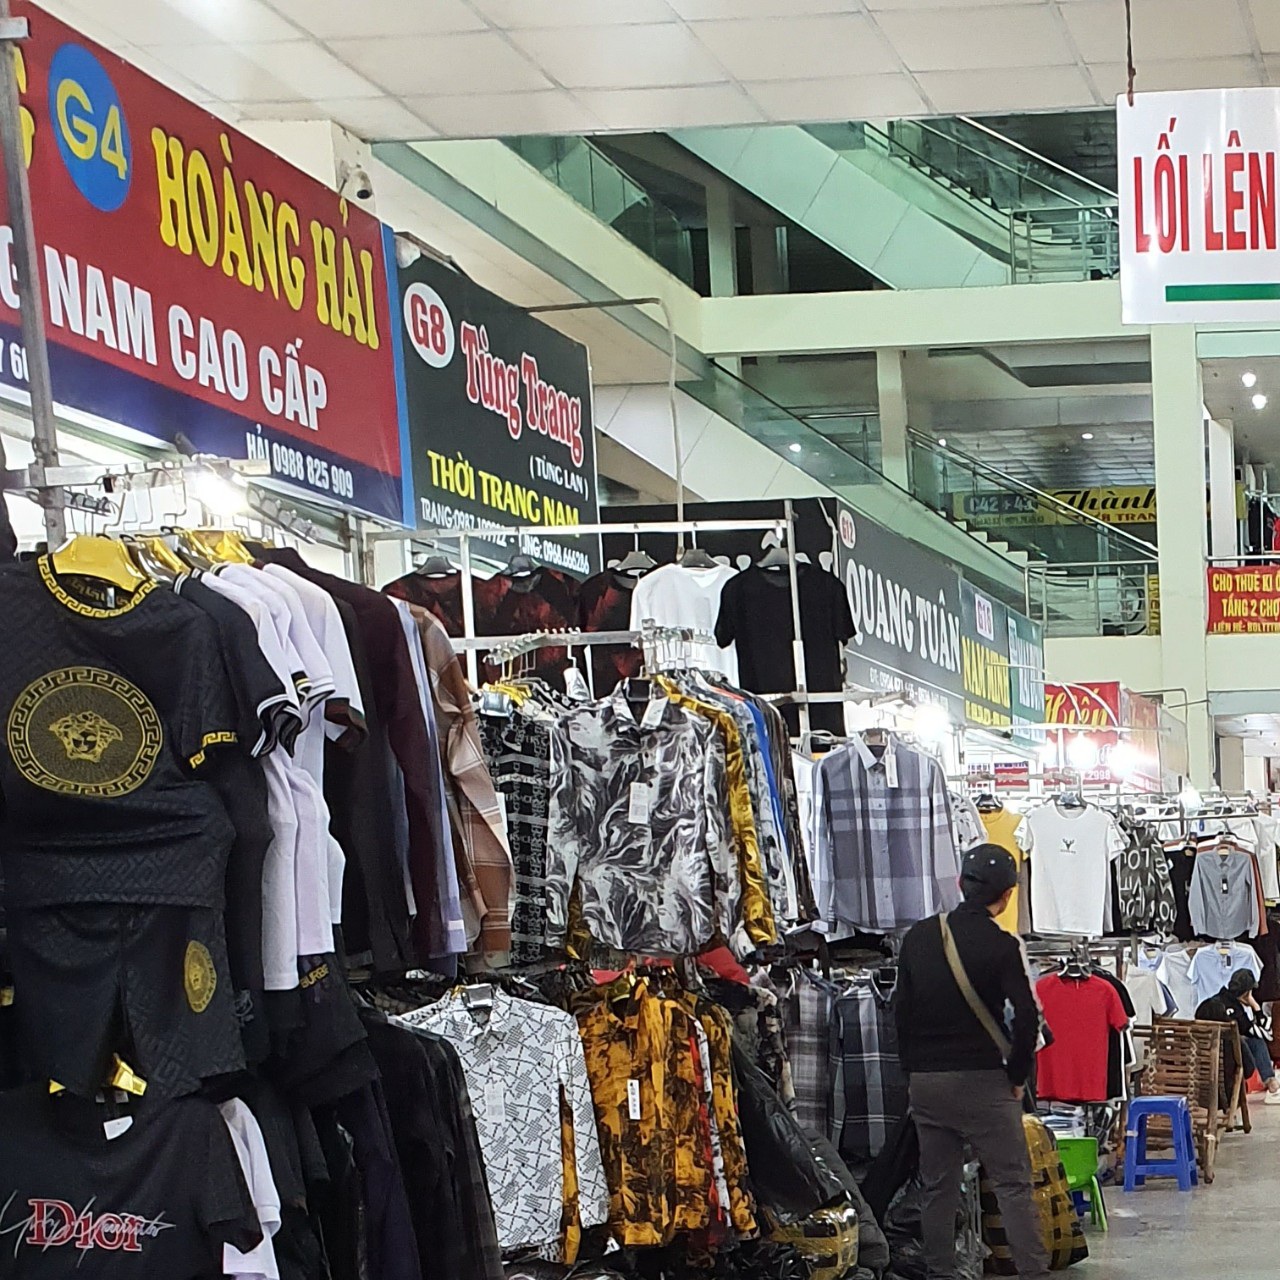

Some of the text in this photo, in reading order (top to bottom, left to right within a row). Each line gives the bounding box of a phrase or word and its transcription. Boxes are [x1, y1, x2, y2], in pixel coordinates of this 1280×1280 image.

[57, 78, 127, 180] G4
[1133, 117, 1190, 253] LỐI
[1203, 130, 1276, 251] LÊN
[151, 130, 305, 311] HOÀNG
[310, 199, 380, 349] HẢI
[44, 244, 158, 367] NAM
[167, 304, 249, 402] CAO
[259, 338, 328, 431] CẤP
[409, 292, 447, 357] G8
[461, 321, 584, 468] Tùng Trang
[273, 442, 305, 481] 0988
[306, 455, 330, 490] 825
[331, 465, 354, 499] 909
[427, 450, 580, 538] THỜI TRANG NAM
[846, 559, 914, 653] QUANG
[1213, 573, 1233, 592] CHO
[1250, 599, 1258, 617] 2
